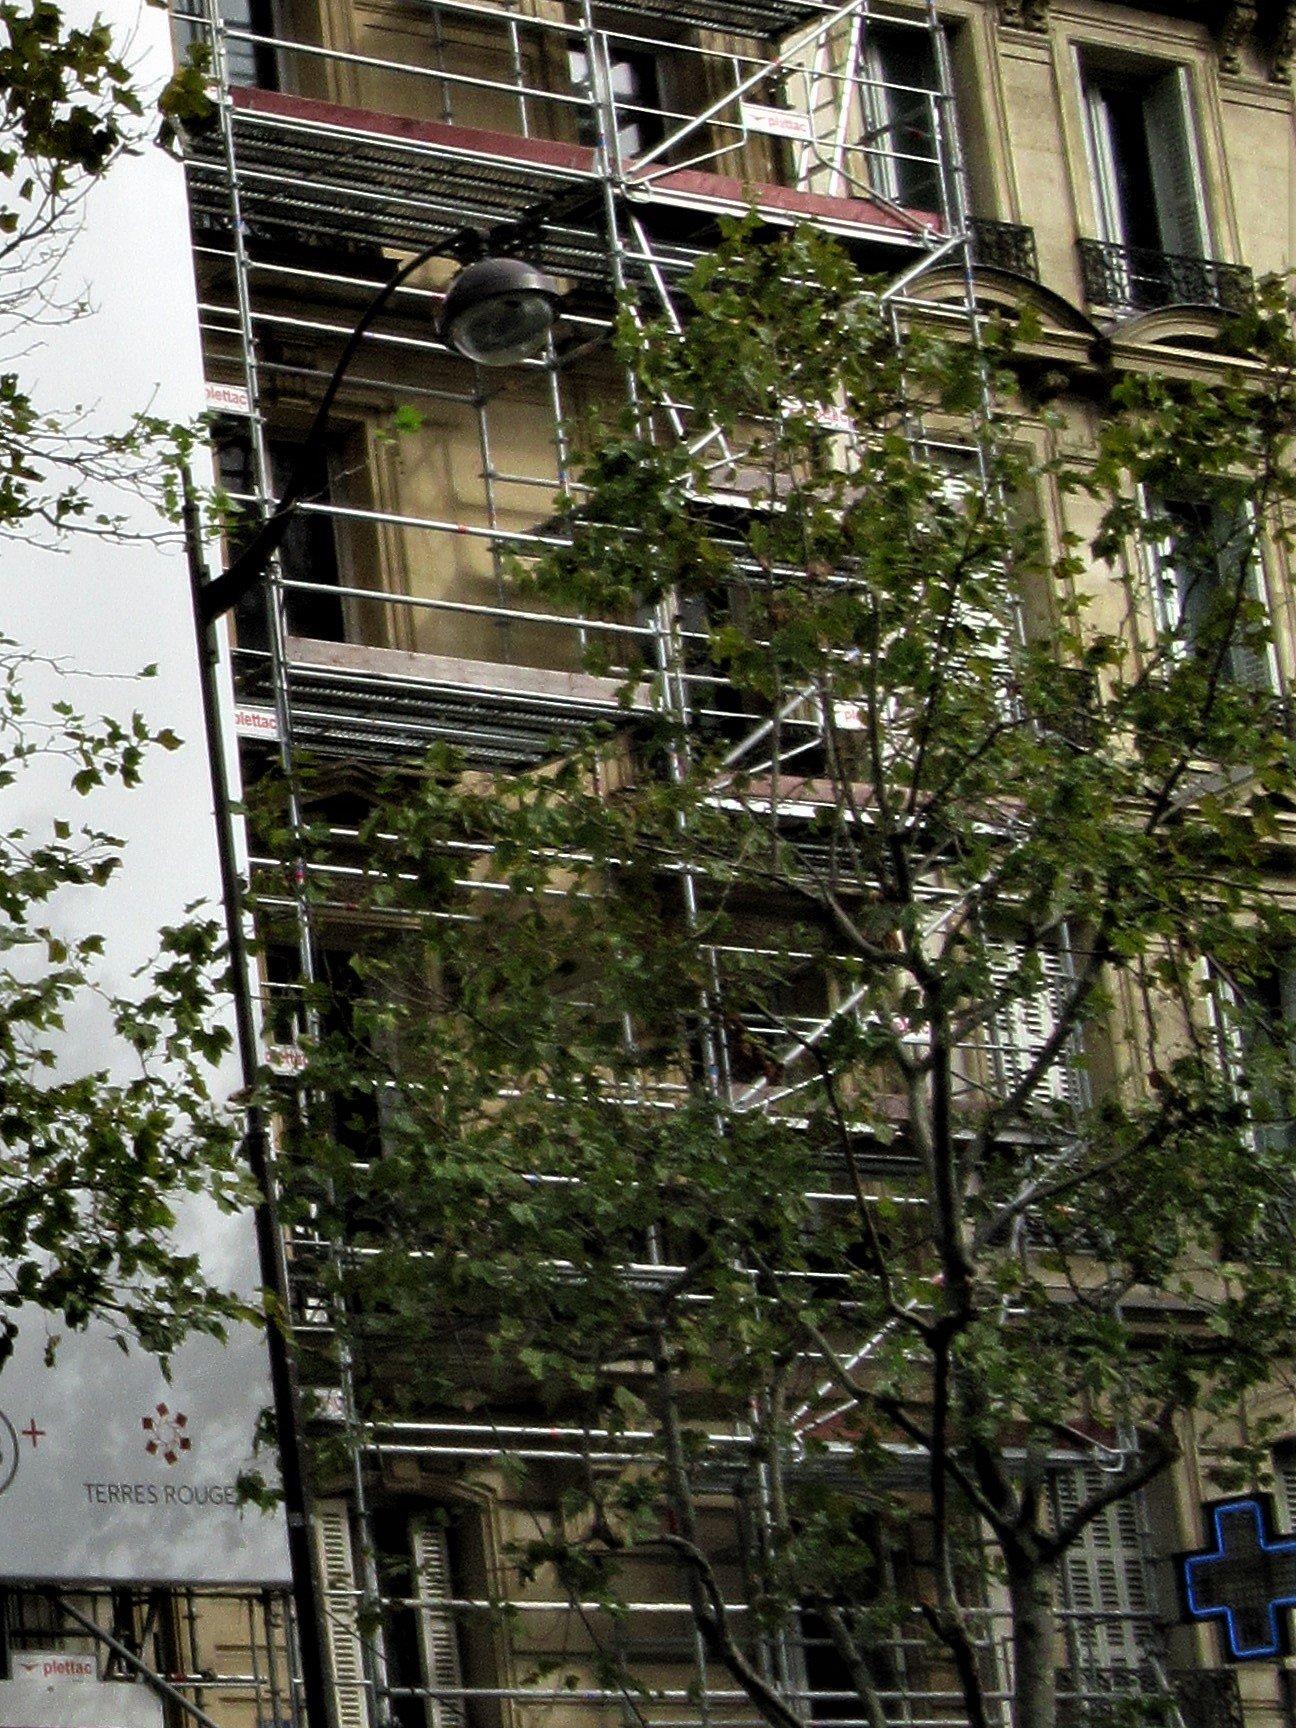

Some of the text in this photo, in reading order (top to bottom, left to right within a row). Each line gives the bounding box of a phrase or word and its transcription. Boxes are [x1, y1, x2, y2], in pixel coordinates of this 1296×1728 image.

[83, 1483, 242, 1506] TERRES ROUGE
[43, 1660, 92, 1676] plettac
